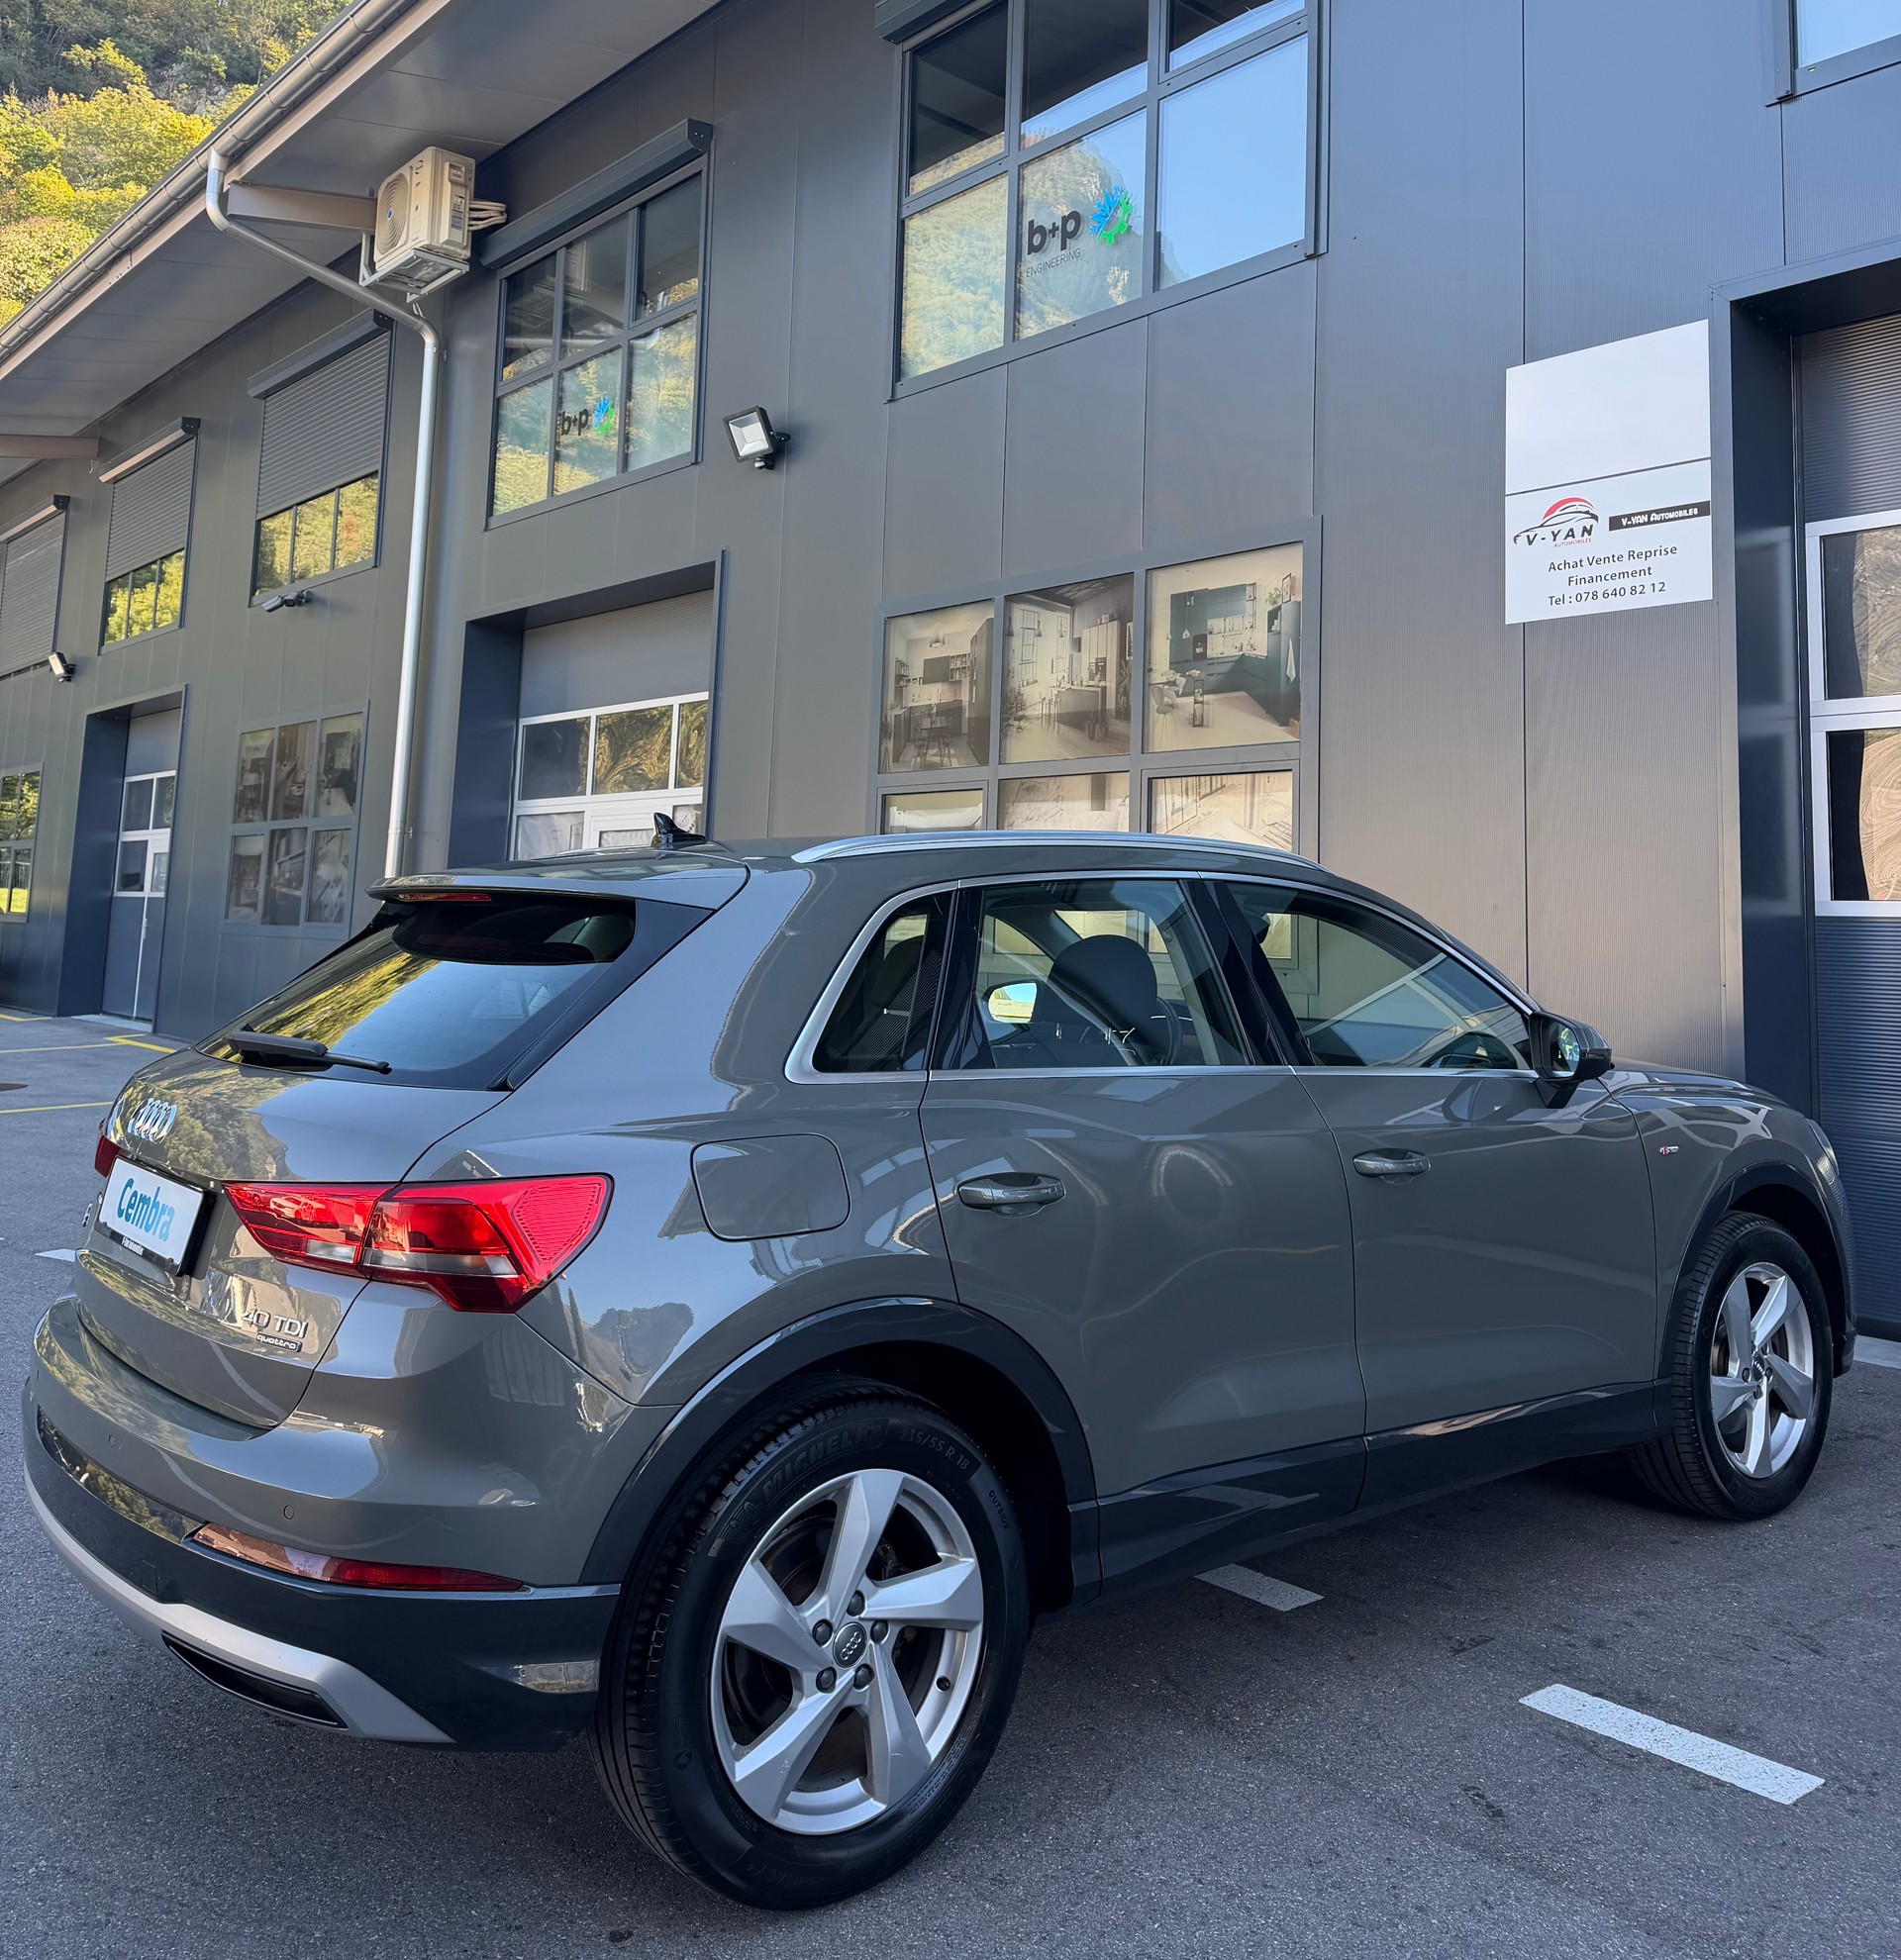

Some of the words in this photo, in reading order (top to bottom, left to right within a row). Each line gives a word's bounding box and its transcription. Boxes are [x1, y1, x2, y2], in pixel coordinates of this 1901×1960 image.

[1026, 247, 1081, 277] ENGINEERING
[1553, 537, 1592, 547] AUTOMOBILES
[1548, 557, 1584, 572] Achat
[1586, 553, 1624, 567] Vente
[1627, 544, 1678, 561] Reprise
[1567, 565, 1652, 587] Financement
[1548, 594, 1565, 607] Tel
[1575, 590, 1599, 603] 078
[1602, 586, 1627, 599] 640
[1630, 584, 1647, 595] 82
[1651, 581, 1666, 593] 12
[116, 1177, 175, 1242] Cembra
[242, 1308, 271, 1329] 40
[273, 1315, 309, 1338] TDI
[256, 1334, 297, 1350] quattro
[761, 1423, 881, 1503] MICHELIN
[945, 1445, 956, 1460] R
[955, 1453, 970, 1471] 18
[987, 1489, 1011, 1530] OUTSIDE
